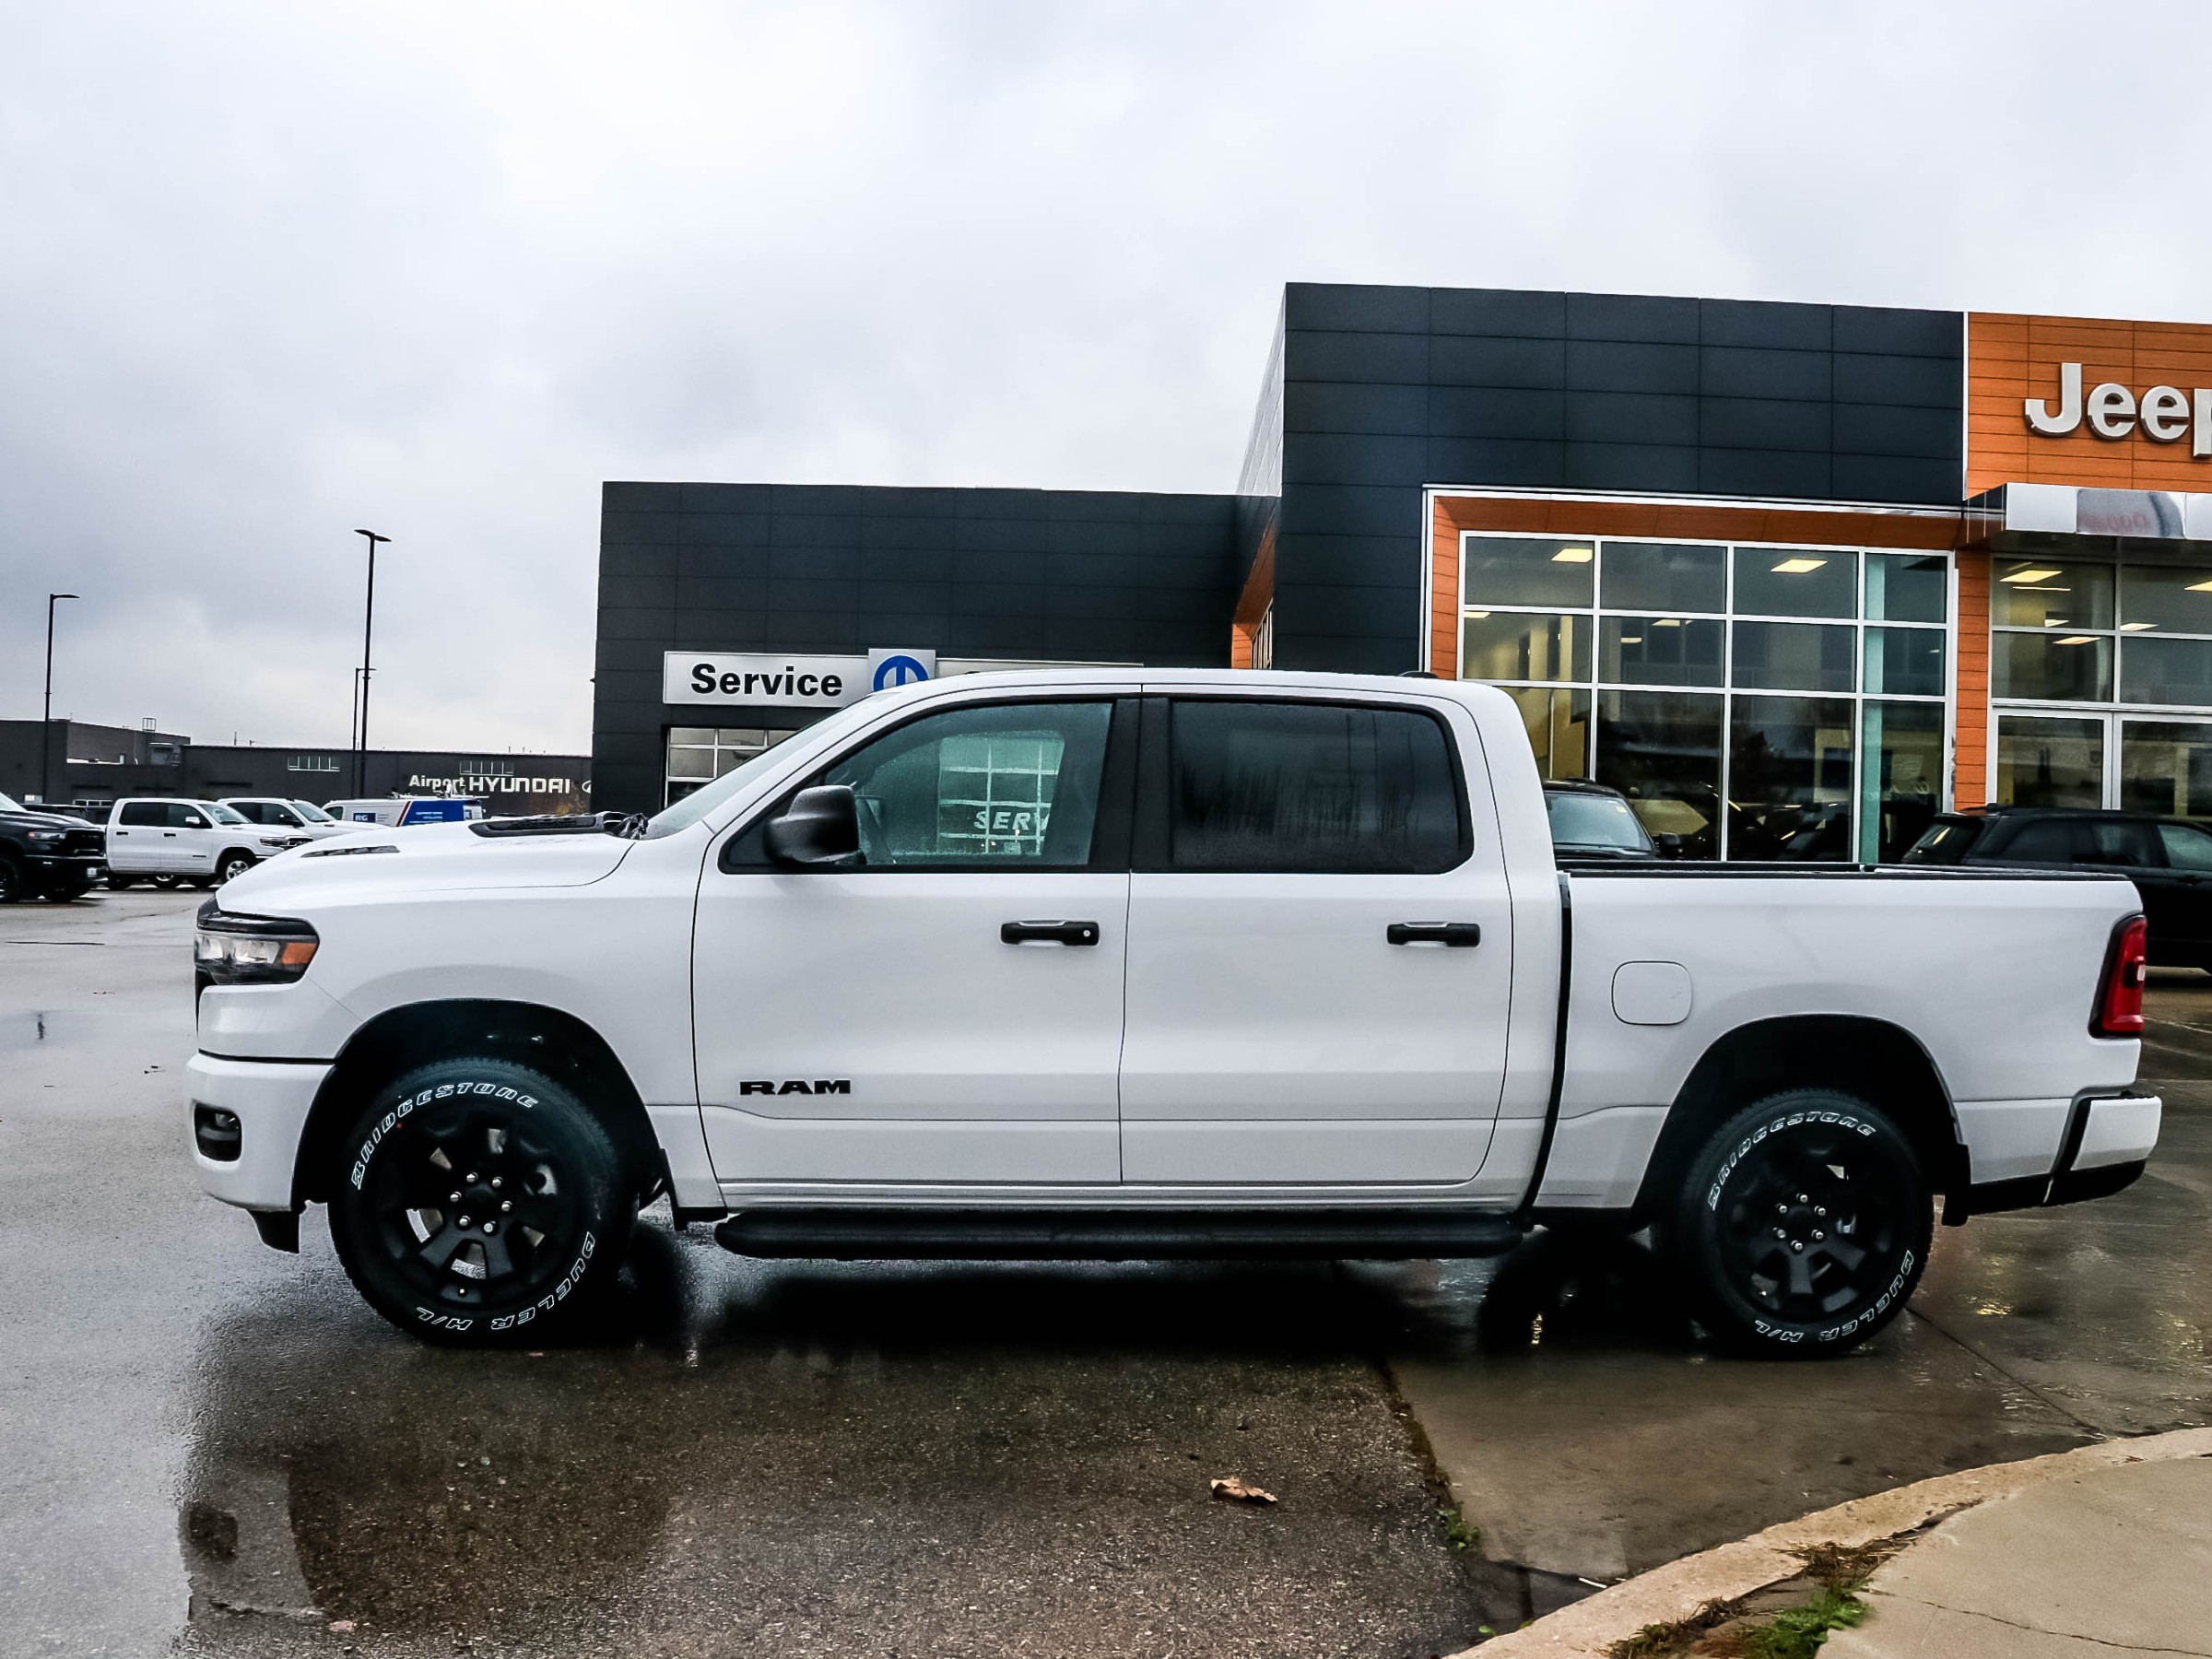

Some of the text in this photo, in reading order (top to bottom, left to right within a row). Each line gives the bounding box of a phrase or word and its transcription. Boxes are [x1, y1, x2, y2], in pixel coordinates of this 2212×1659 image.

[691, 663, 843, 696] Service
[409, 775, 571, 794] Airport HYUNDAI
[739, 1080, 851, 1095] RAM
[351, 1082, 538, 1190] BRIDGESTONE
[1708, 1112, 1876, 1211] BRIDGESTONE
[417, 1231, 595, 1330] DUELER H/L
[1755, 1250, 1914, 1342] DUELER H/L
